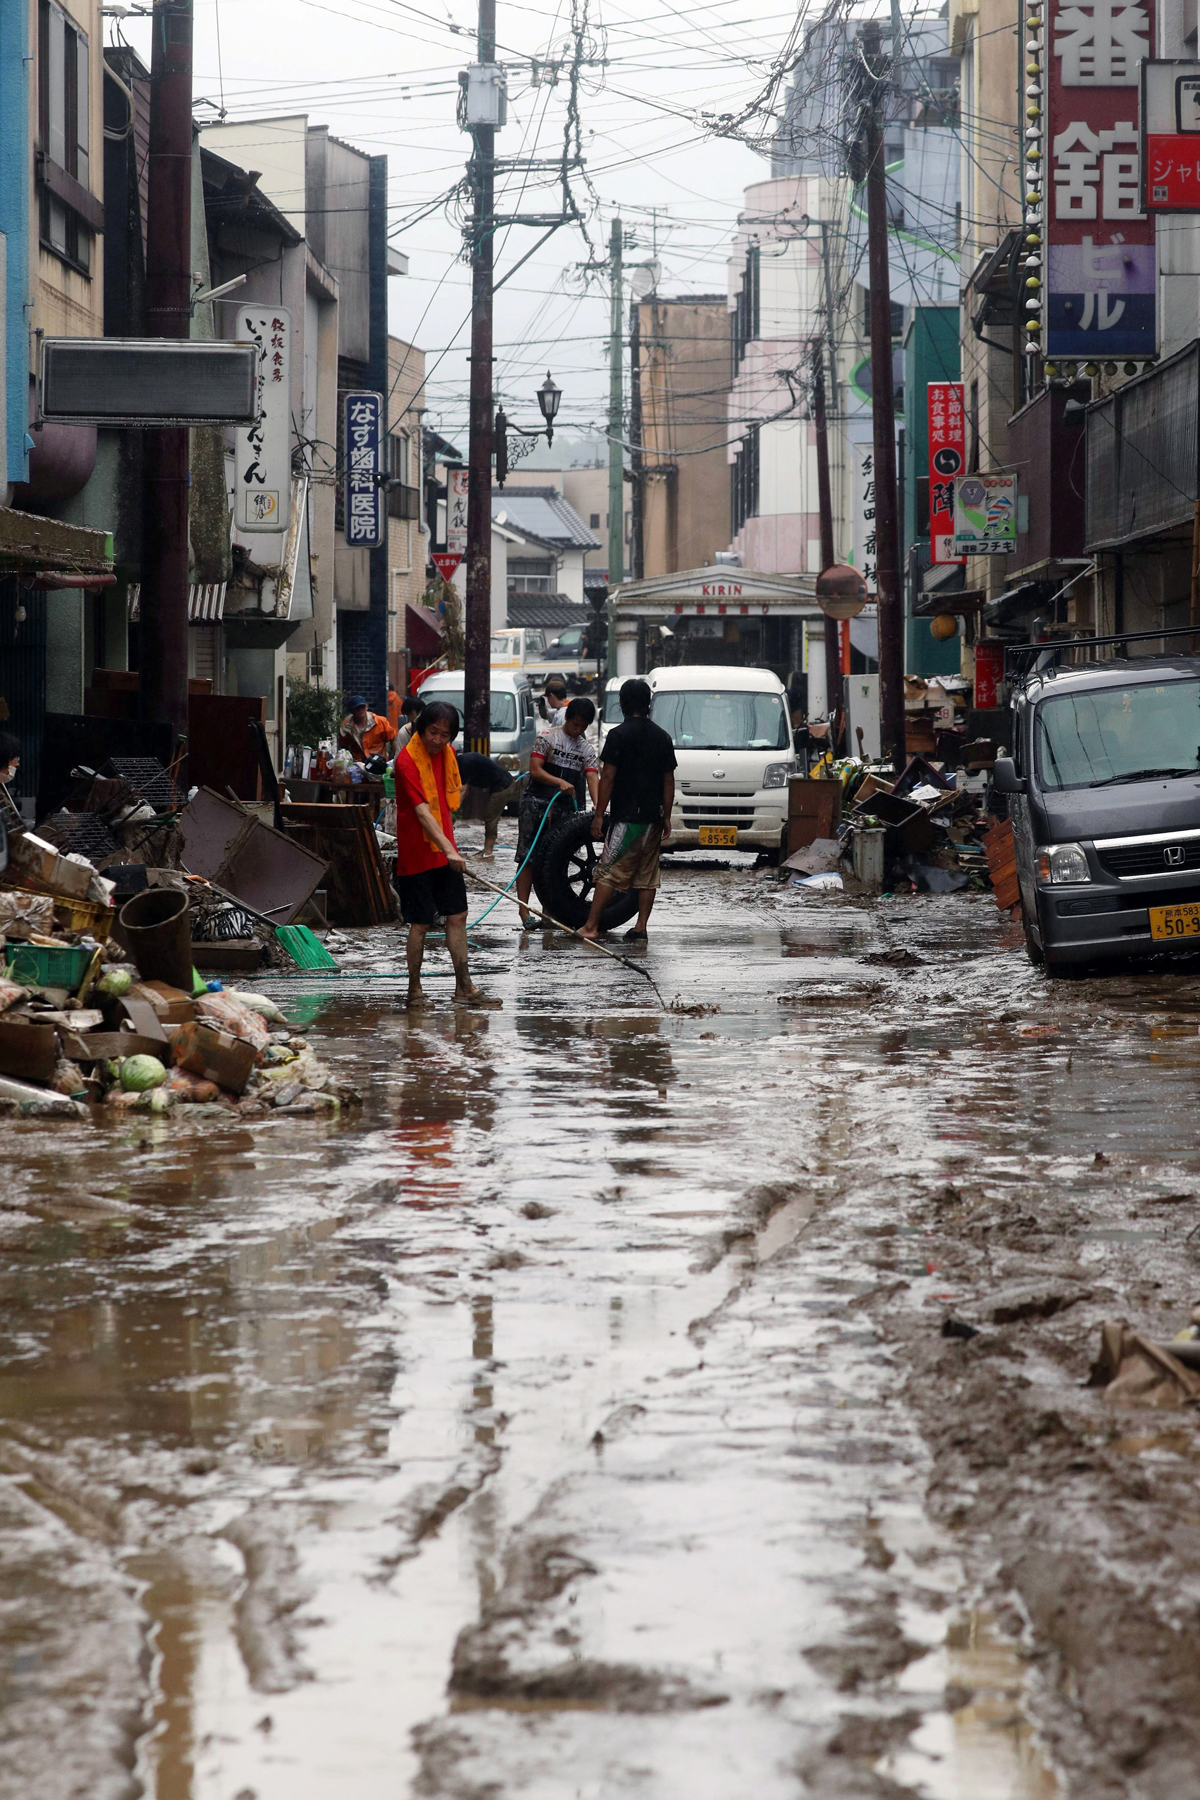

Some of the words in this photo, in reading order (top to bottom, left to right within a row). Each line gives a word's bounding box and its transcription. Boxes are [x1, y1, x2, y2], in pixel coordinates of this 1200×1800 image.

[1153, 158, 1200, 184] ジャ
[931, 388, 946, 443] お食事処
[948, 387, 963, 443] 季節料理
[350, 401, 376, 540] なす歯科医院
[438, 558, 457, 566] 止まれ
[702, 585, 742, 596] KIRIN
[978, 680, 988, 703] そば
